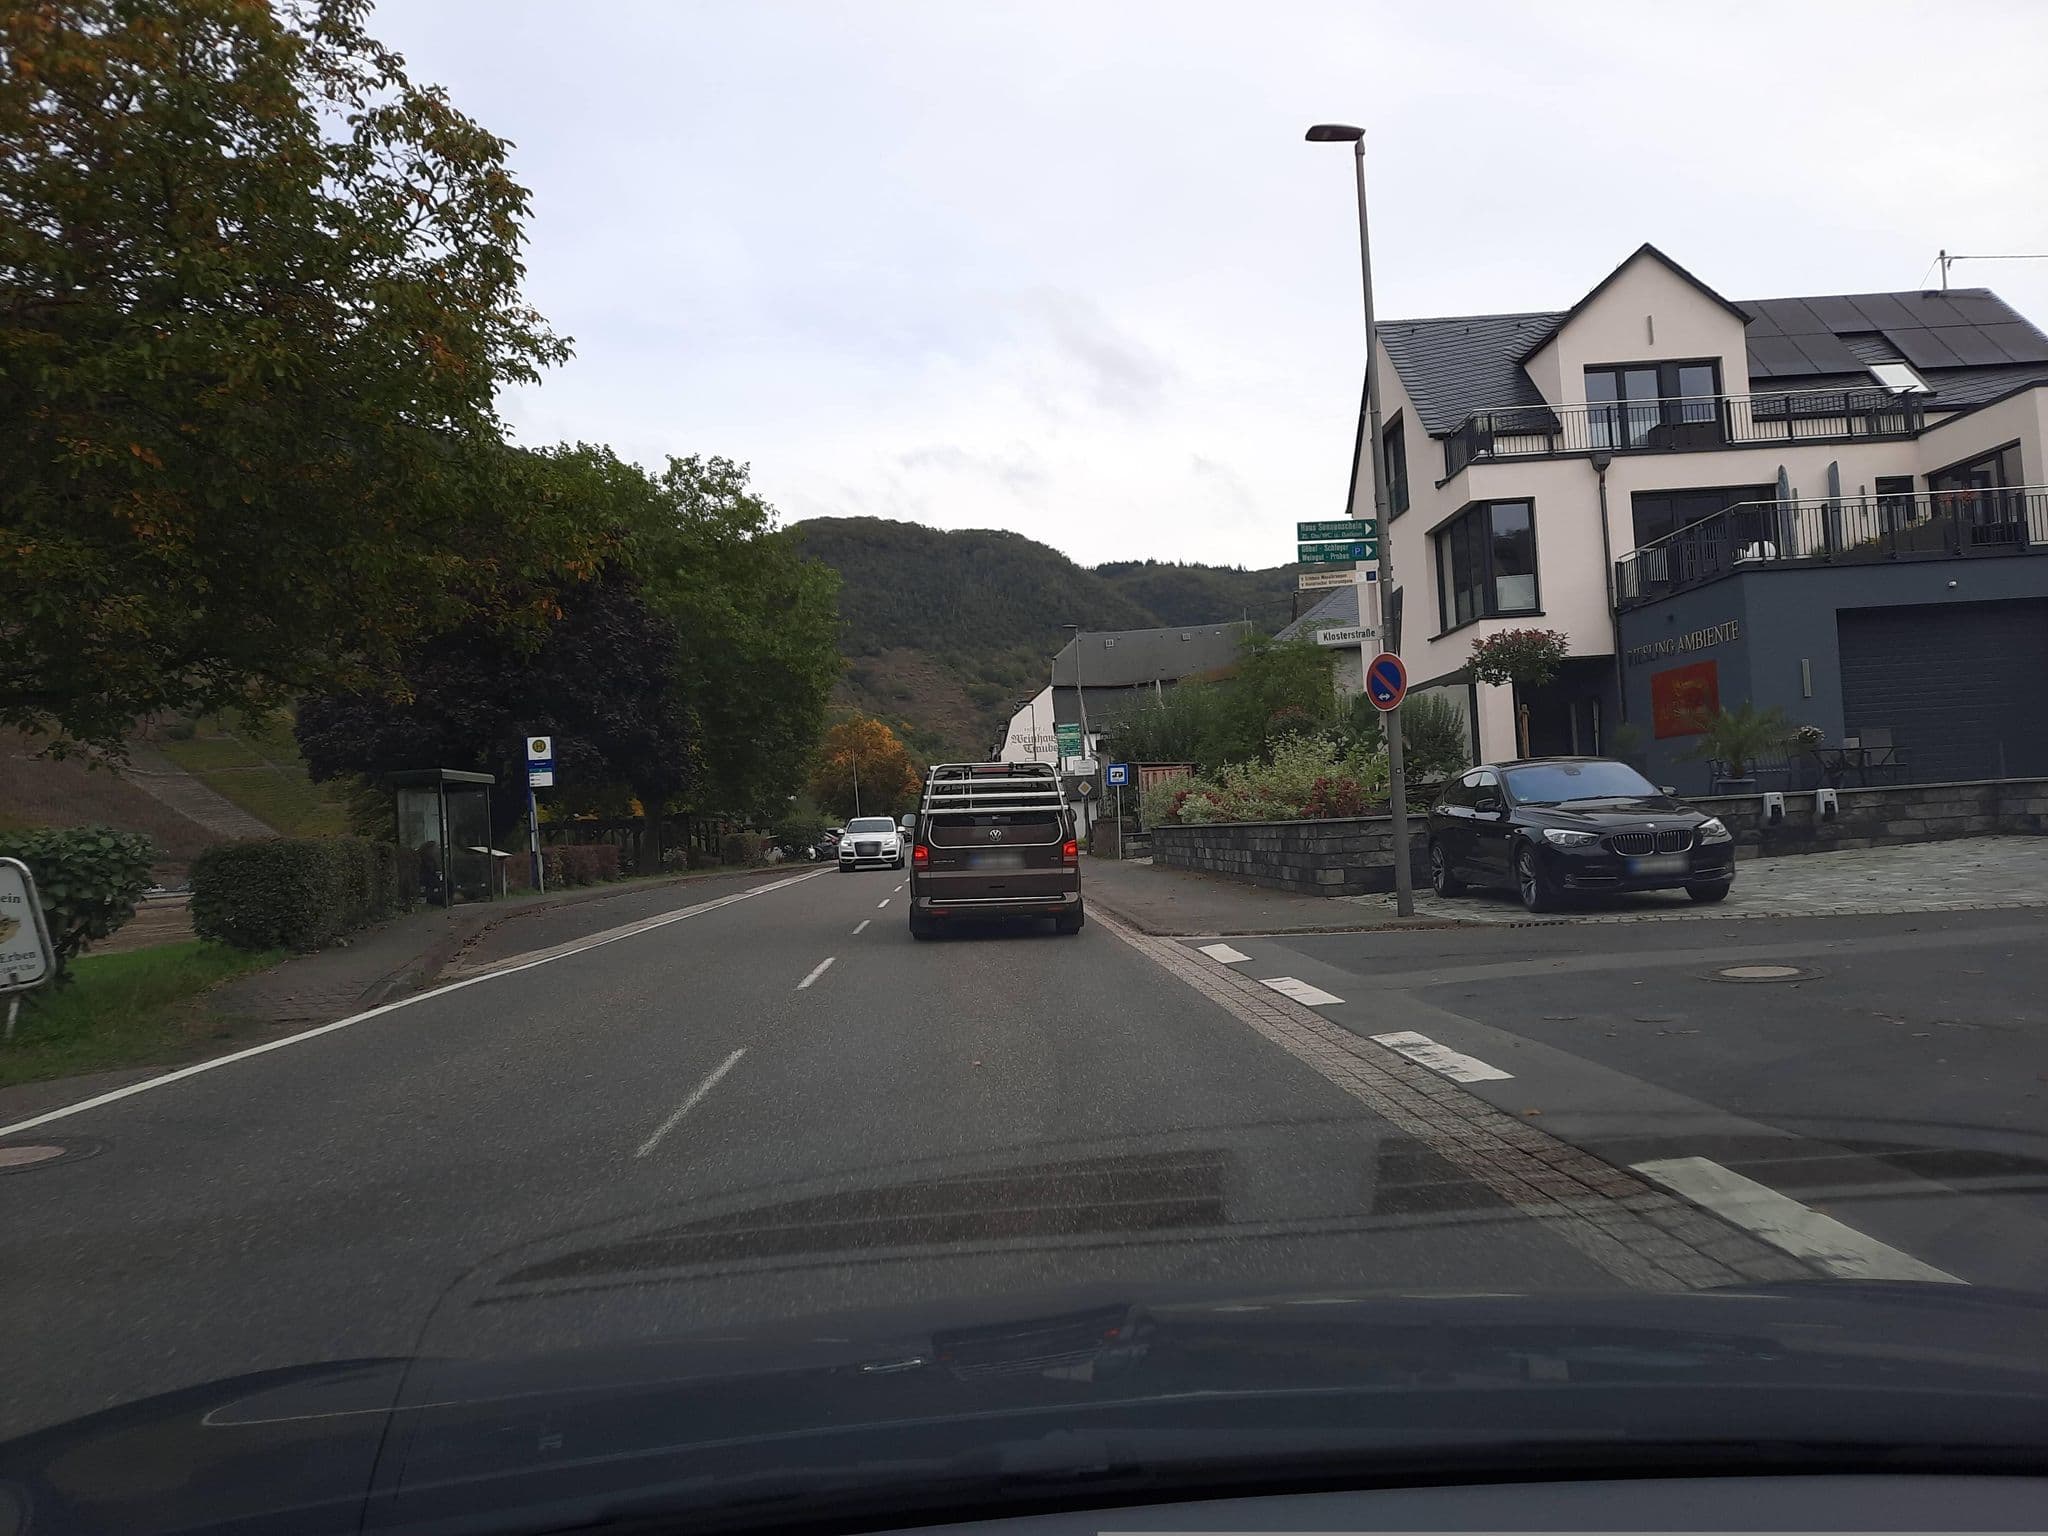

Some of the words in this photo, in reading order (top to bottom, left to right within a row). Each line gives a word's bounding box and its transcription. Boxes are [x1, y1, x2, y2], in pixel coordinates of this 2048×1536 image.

[1301, 523, 1316, 532] Haus
[1302, 553, 1325, 562] Weingut
[1323, 628, 1376, 641] Klosterstraße
[1678, 619, 1739, 653] AMBIENTE
